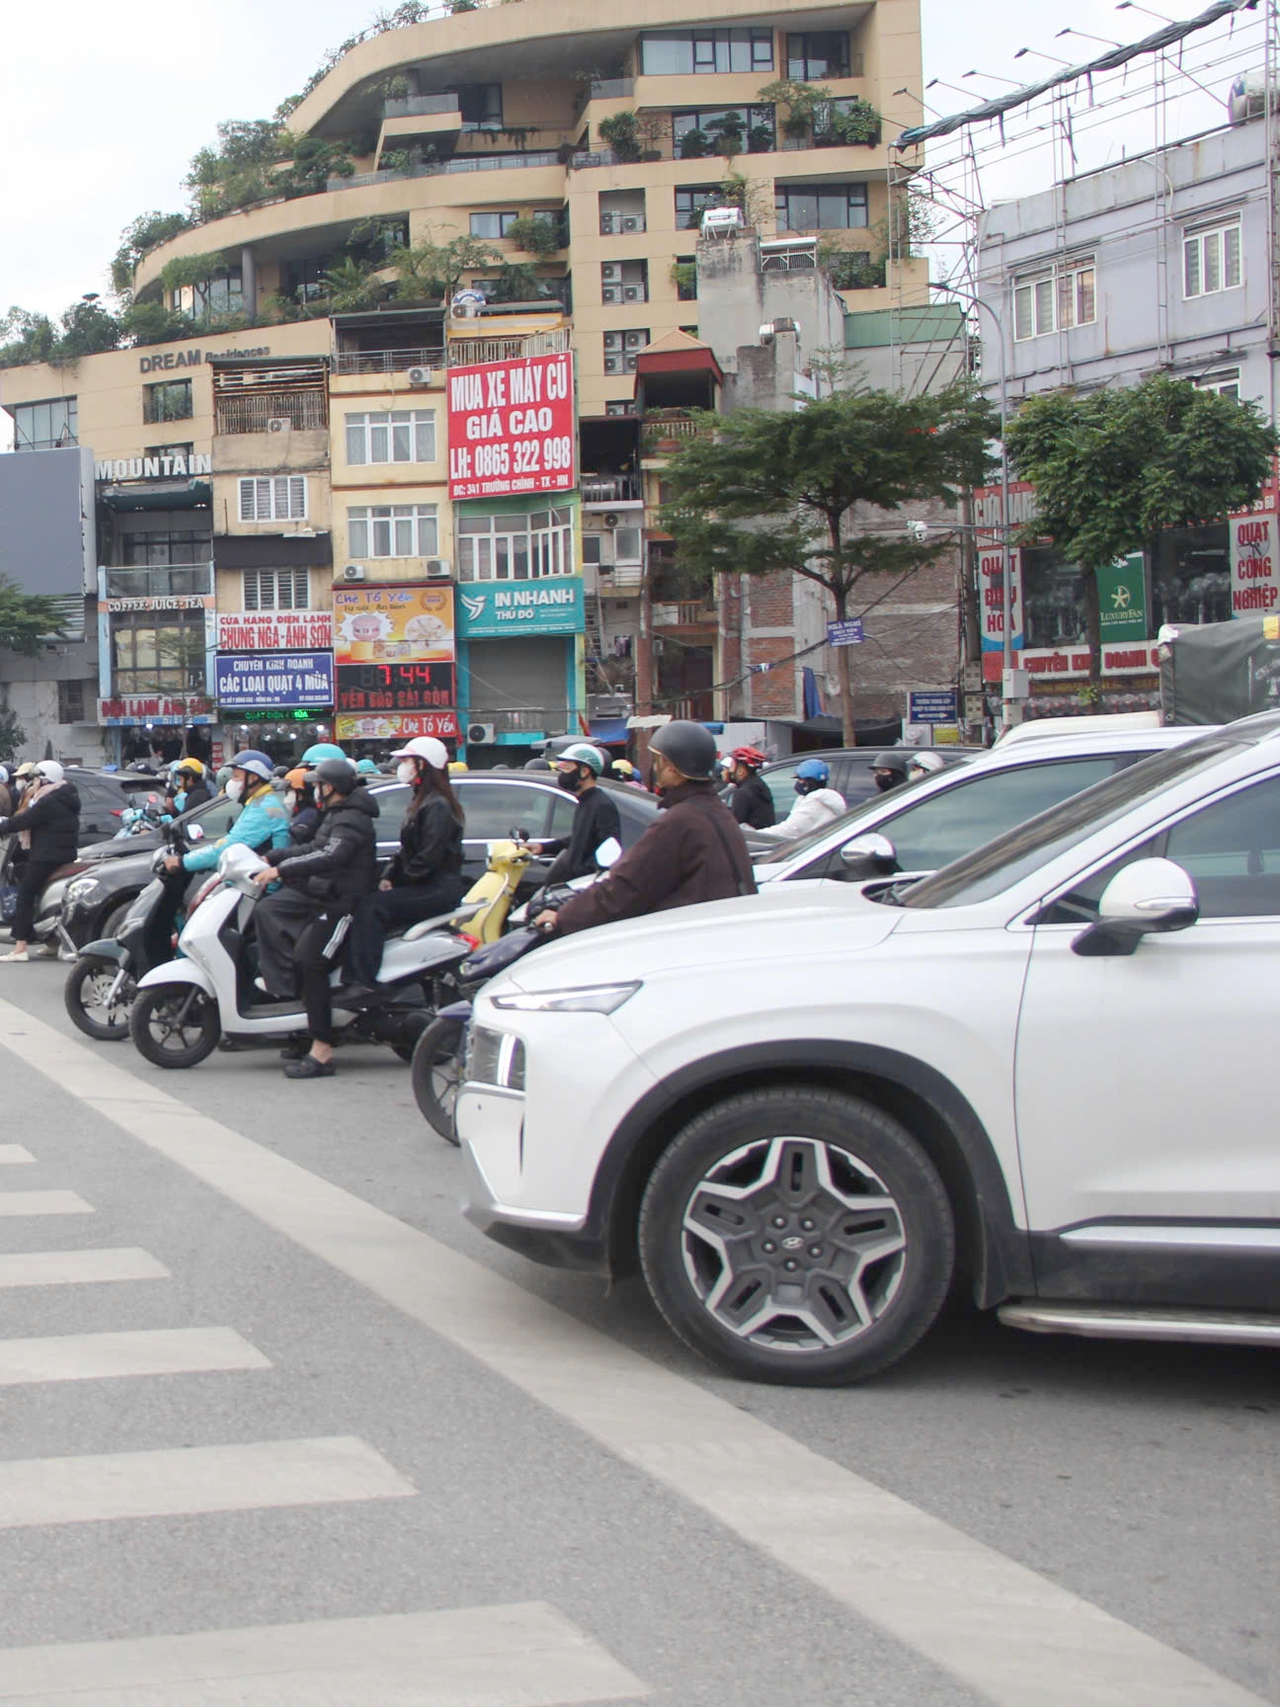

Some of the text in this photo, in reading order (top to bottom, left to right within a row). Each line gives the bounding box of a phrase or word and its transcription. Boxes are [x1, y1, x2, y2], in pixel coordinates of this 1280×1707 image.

[139, 349, 201, 373] DREAM
[451, 355, 568, 412] MUA XE MÁY CŨ
[466, 406, 553, 440] GIÁ CAO
[94, 453, 212, 480] MOUNTAIN
[450, 436, 570, 480] LH: 0865 322 998
[467, 483, 480, 494] 341
[541, 477, 551, 488] TX
[557, 474, 569, 486] HN
[1237, 521, 1270, 547] QUẠT
[1237, 554, 1273, 580] CÔNG
[495, 588, 574, 607] IN NHANH
[1233, 583, 1279, 613] NGHIỆP
[220, 626, 256, 649] CHUNG
[257, 625, 280, 649] NGA
[309, 625, 332, 649] SƠN
[233, 658, 314, 672] CHUYÊN KINH DOANH
[220, 671, 329, 696] CÁC LOẠI QUẠT 4 MÙA
[402, 716, 419, 733] Chè
[435, 714, 456, 733] Yến
